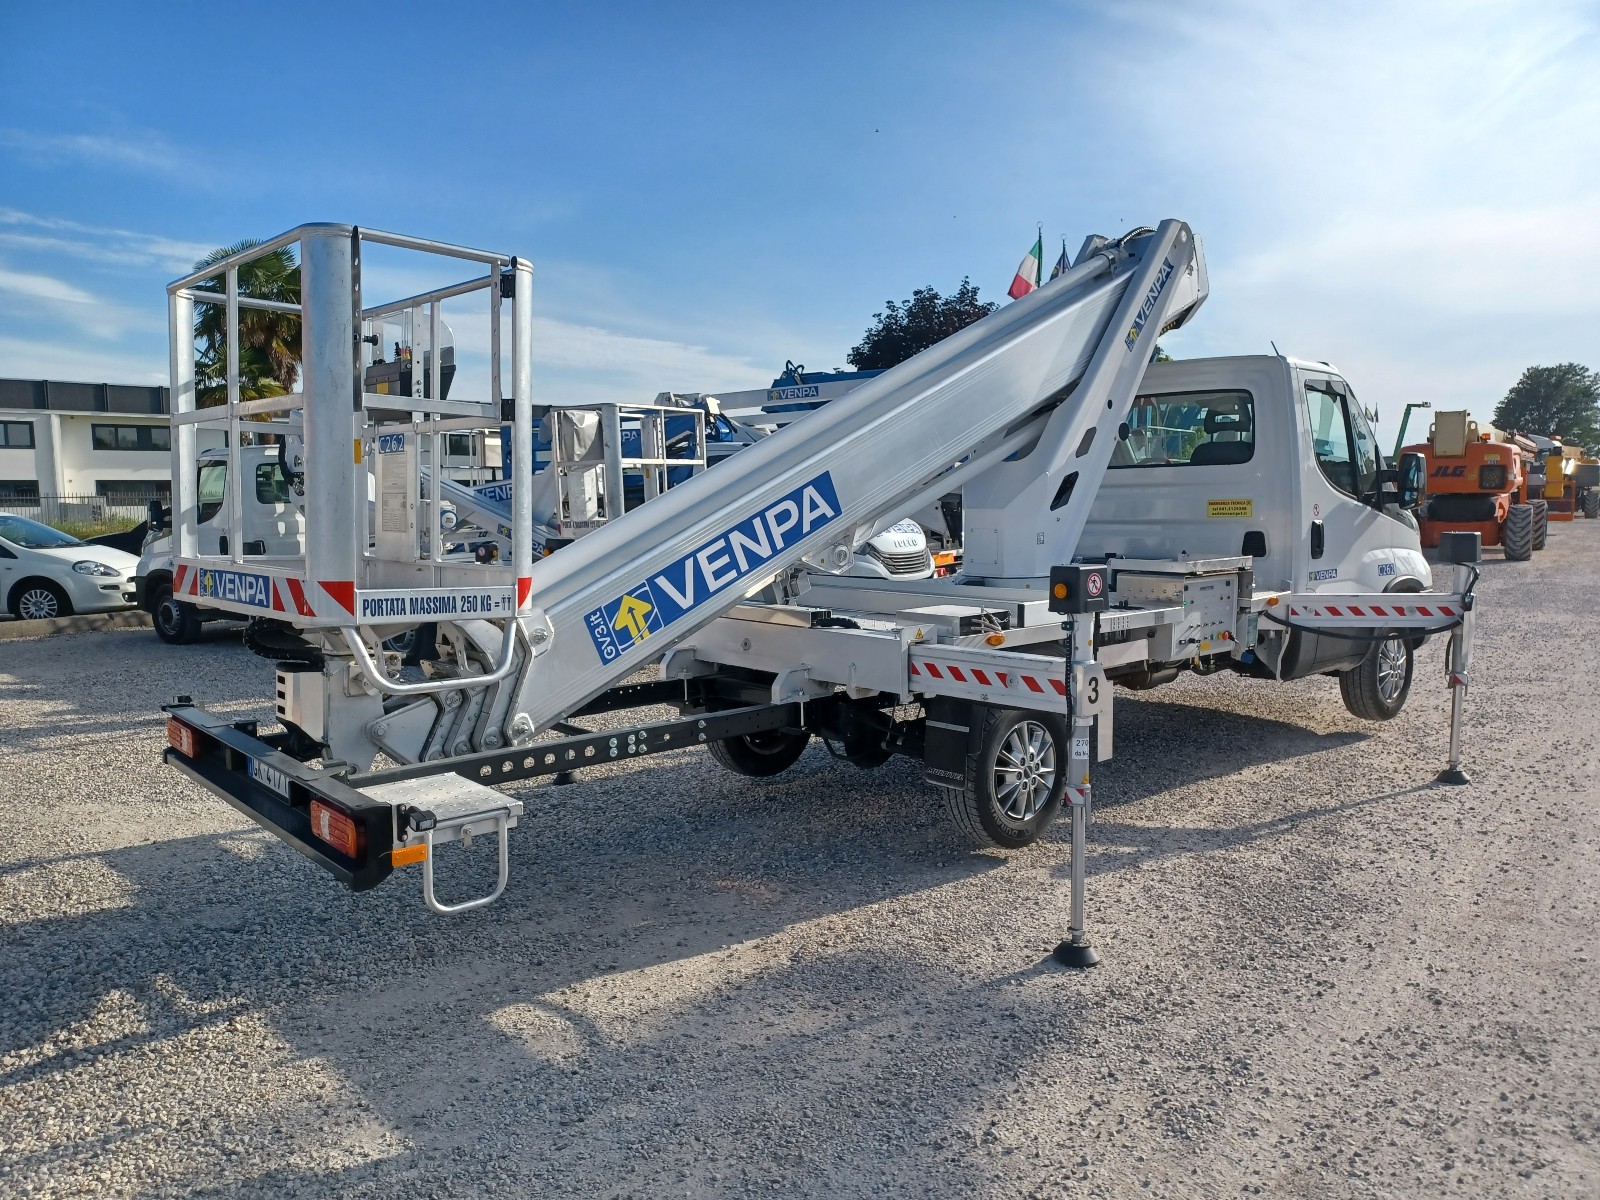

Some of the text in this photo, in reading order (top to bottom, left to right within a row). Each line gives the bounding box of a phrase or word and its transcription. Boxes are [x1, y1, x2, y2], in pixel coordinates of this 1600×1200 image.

[1136, 265, 1171, 326] VENPA
[780, 386, 818, 400] VENPA
[380, 434, 404, 454] C262
[1430, 465, 1467, 478] JLG
[655, 485, 836, 610] VENPA
[1316, 569, 1338, 580] VENPA
[1379, 564, 1395, 577] C262
[215, 572, 268, 606] VENPA
[362, 597, 407, 618] PORTATA
[409, 595, 458, 616] MASSIMA
[460, 594, 478, 614] 250
[480, 594, 492, 613] KG
[589, 611, 616, 660] GV3.it
[1087, 676, 1099, 705] 3
